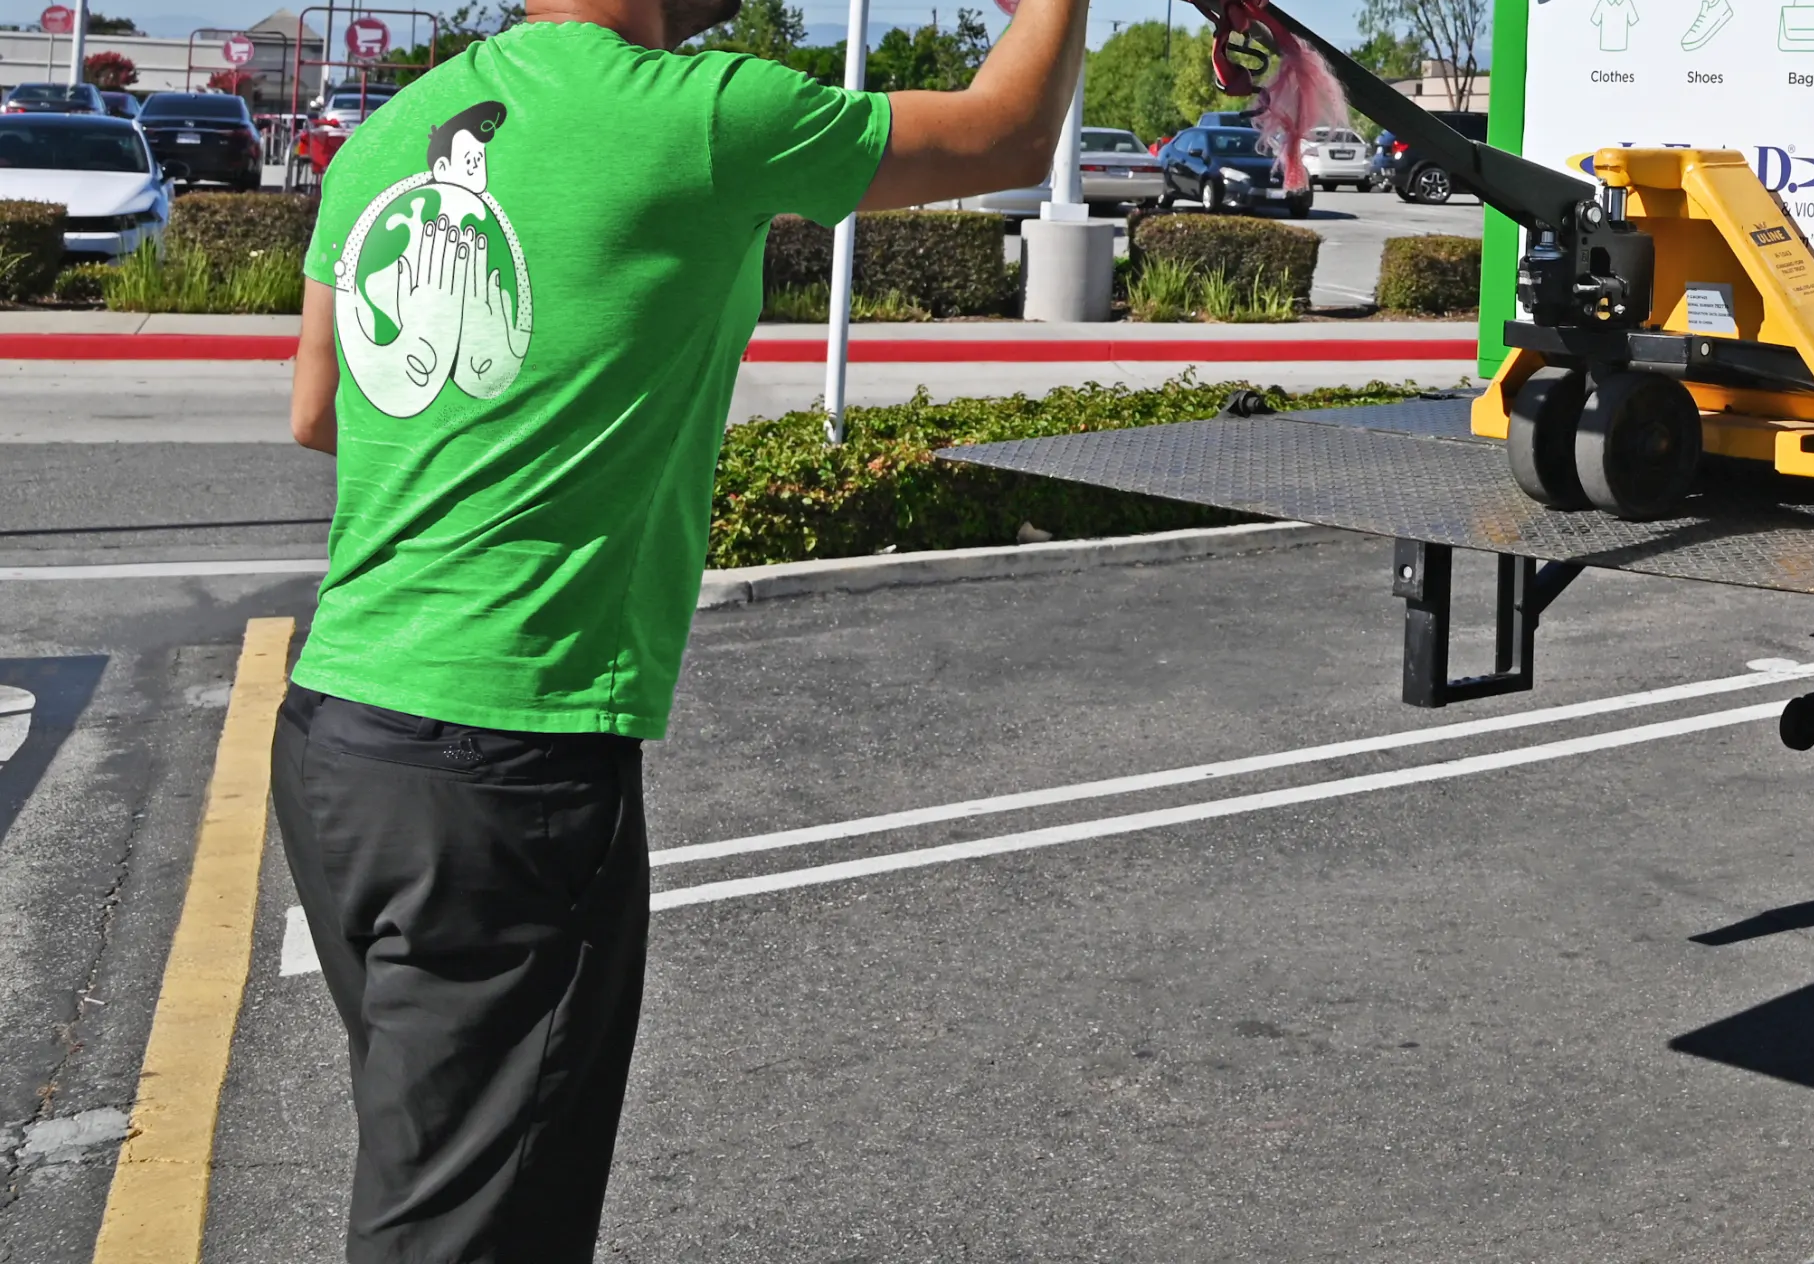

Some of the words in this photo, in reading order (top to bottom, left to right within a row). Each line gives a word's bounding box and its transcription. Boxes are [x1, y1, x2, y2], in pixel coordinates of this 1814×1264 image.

[1590, 70, 1635, 83] Clothes
[1687, 70, 1724, 84] Shoes
[1782, 202, 1791, 217] &
[1756, 230, 1786, 243] ULINE
